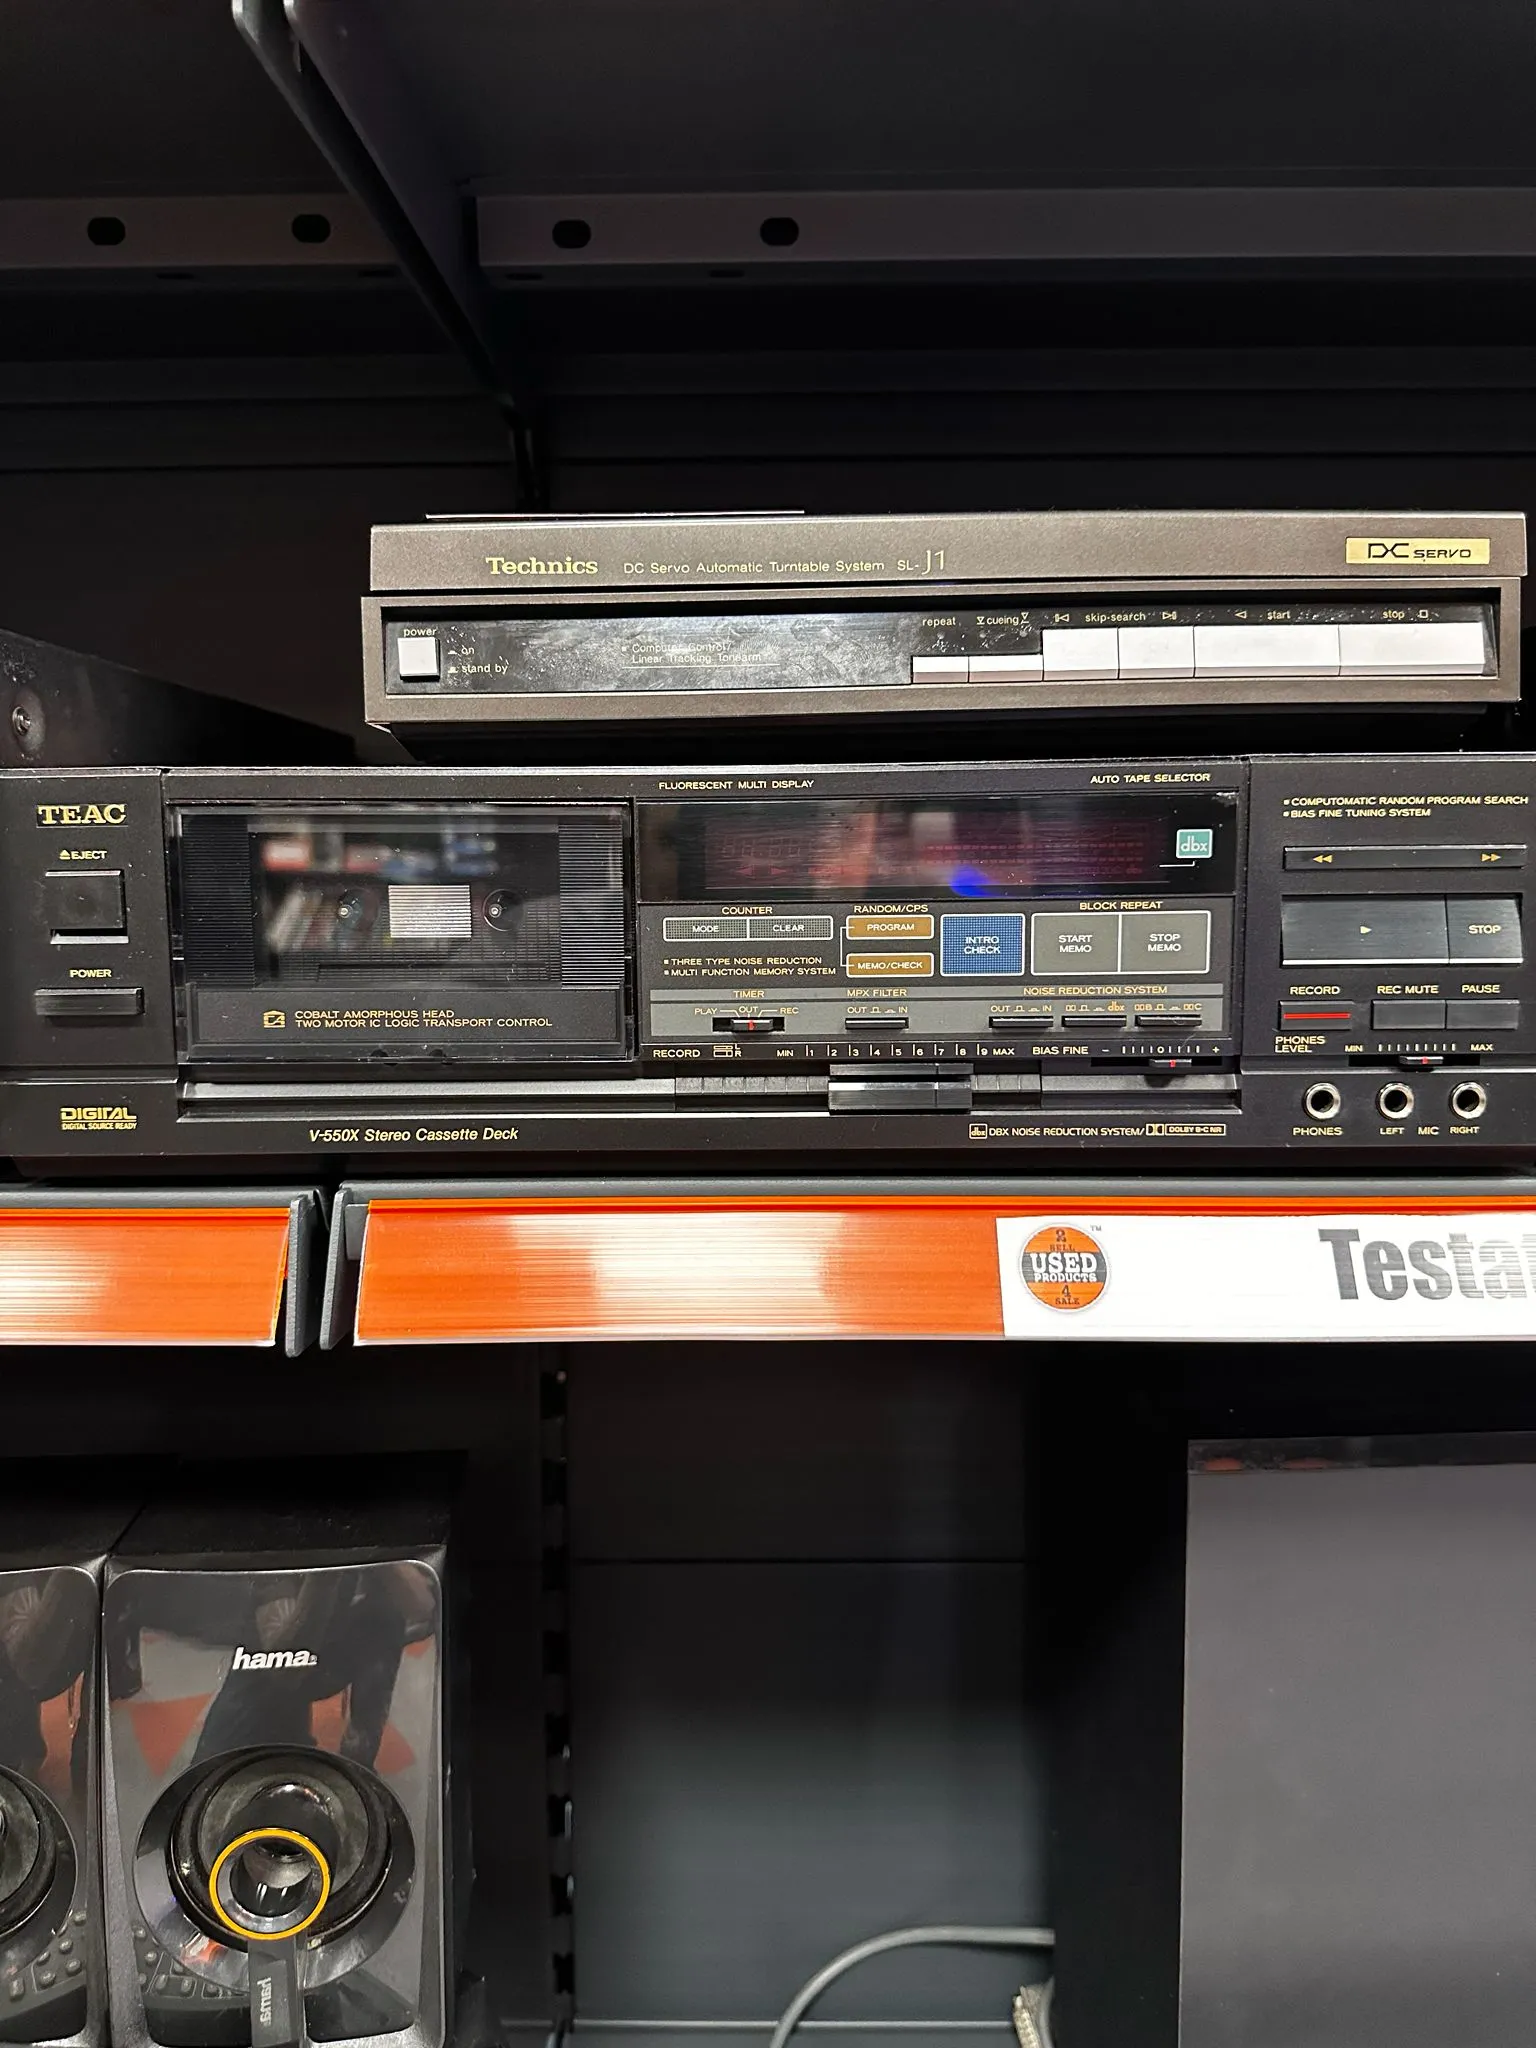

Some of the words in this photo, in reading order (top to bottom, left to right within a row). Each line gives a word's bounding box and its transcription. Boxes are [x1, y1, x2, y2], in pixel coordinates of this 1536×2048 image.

[1368, 543, 1409, 558] DC
[1413, 549, 1471, 558] SERVO
[486, 557, 598, 575] Technics
[624, 563, 644, 574] DC
[650, 563, 690, 574] Servo
[696, 562, 762, 573] Automatic
[769, 561, 829, 573] Turntable
[835, 561, 884, 575] System
[1267, 610, 1291, 620] start
[1383, 610, 1404, 622] stop
[922, 616, 956, 628] repeat
[987, 616, 1019, 627] cueing
[404, 628, 437, 637] power
[461, 647, 474, 655] on
[632, 655, 663, 664] Linear
[669, 654, 712, 665] Tracking
[718, 653, 761, 662] Tonearm
[461, 664, 490, 673] stand
[495, 664, 508, 675] by
[1090, 775, 1119, 784] AUTO
[1124, 775, 1150, 783] TAPE
[1154, 774, 1210, 783] SELECTOR
[659, 781, 733, 790] FLUORESCENT
[738, 781, 766, 789] MULTI
[772, 780, 814, 789] DISPLAY
[1291, 796, 1376, 807] COMPUTOMATIC
[1379, 796, 1425, 806] RANDOM
[1427, 796, 1480, 805] PROGRAM
[1484, 796, 1528, 805] SEARCH
[38, 804, 127, 825] TEAC
[1291, 809, 1316, 818] BIAS
[1318, 809, 1342, 817] FINE
[1345, 808, 1386, 817] TUNING
[1388, 808, 1431, 817] SYSTEM
[1180, 836, 1207, 852] dbx
[71, 851, 107, 860] EJECT
[854, 904, 928, 913] RANDOM/CPS
[1079, 902, 1117, 910] BLOCK
[1120, 901, 1163, 910] REPEAT
[722, 906, 772, 915] COUNTER
[692, 925, 719, 933] MODE
[773, 924, 804, 932] CLEAR
[867, 923, 915, 931] PROGRAM
[1468, 925, 1501, 934] STOP
[965, 936, 999, 944] INTRO
[1059, 934, 1092, 943] START
[1149, 933, 1181, 942] STOP
[964, 946, 1000, 955] CHECK
[1059, 944, 1092, 953] MEMO
[1147, 943, 1181, 952] MEMO
[671, 958, 702, 966] THREE
[706, 957, 730, 965] TYPE
[734, 957, 762, 965] NOISE
[767, 956, 822, 965] REDUCTION
[858, 961, 923, 970] MEMO/CHECK
[70, 970, 112, 978] POWER
[671, 968, 697, 977] MULTI
[702, 968, 749, 976] FUNCTION
[754, 968, 793, 976] MEMORY
[797, 967, 836, 975] SYSTEM
[847, 989, 870, 997] MPX
[873, 988, 907, 997] FILTER
[1024, 987, 1055, 995] NOISE
[1059, 986, 1121, 995] REDUCTION
[1124, 986, 1168, 994] SYSTEM
[1290, 986, 1340, 995] RECORD
[1377, 985, 1401, 995] REC
[1405, 985, 1439, 994] MUTE
[1461, 984, 1500, 994] PAUSE
[734, 990, 764, 998] TIMER
[694, 1007, 718, 1015] PLAY
[847, 1006, 867, 1014] OUT
[899, 1006, 908, 1014] IN
[990, 1005, 1010, 1013] OUT
[1042, 1004, 1052, 1012] IN
[1108, 1001, 1125, 1012] dbx
[295, 1010, 339, 1019] COBALT
[343, 1010, 419, 1019] AMORPHOUS
[423, 1009, 454, 1018] HEAD
[296, 1019, 322, 1028] TWO
[325, 1019, 366, 1028] MOTOR
[369, 1019, 380, 1028] IC
[385, 1019, 419, 1028] LOGIC
[423, 1018, 493, 1027] TRANSPORT
[497, 1017, 552, 1027] CONTROL
[1276, 1035, 1326, 1045] PHONES
[831, 1049, 837, 1057] 2
[938, 1048, 945, 1056] 7
[960, 1048, 966, 1056] 8
[981, 1048, 988, 1056] 9
[993, 1048, 1015, 1056] MAX
[1033, 1047, 1059, 1055] BIAS
[1062, 1046, 1089, 1055] FINE
[1275, 1044, 1312, 1053] LEVEL
[1345, 1044, 1363, 1053] MIN
[1471, 1043, 1493, 1052] MAX
[653, 1049, 701, 1058] RECORD
[61, 1107, 137, 1120] DIGITAL
[62, 1122, 88, 1130] DIGITAL
[88, 1122, 114, 1130] SOURCE
[115, 1122, 137, 1130] READY
[1380, 1126, 1404, 1135] LEFT
[1418, 1126, 1439, 1135] MIC
[1450, 1126, 1480, 1135] RIGHT
[309, 1129, 359, 1142] V-550X
[364, 1129, 411, 1142] Stereo
[415, 1128, 478, 1141] Cassette
[483, 1127, 518, 1141] Deck
[989, 1127, 1009, 1136] DBX
[1012, 1127, 1040, 1136] NOISE
[1043, 1127, 1098, 1136] REDUCTION
[1293, 1126, 1342, 1136] PHONES
[1029, 1252, 1097, 1273] USED
[1034, 1272, 1097, 1282] PRODUCTS
[1062, 1284, 1071, 1298] 4
[1055, 1297, 1080, 1305] SALE
